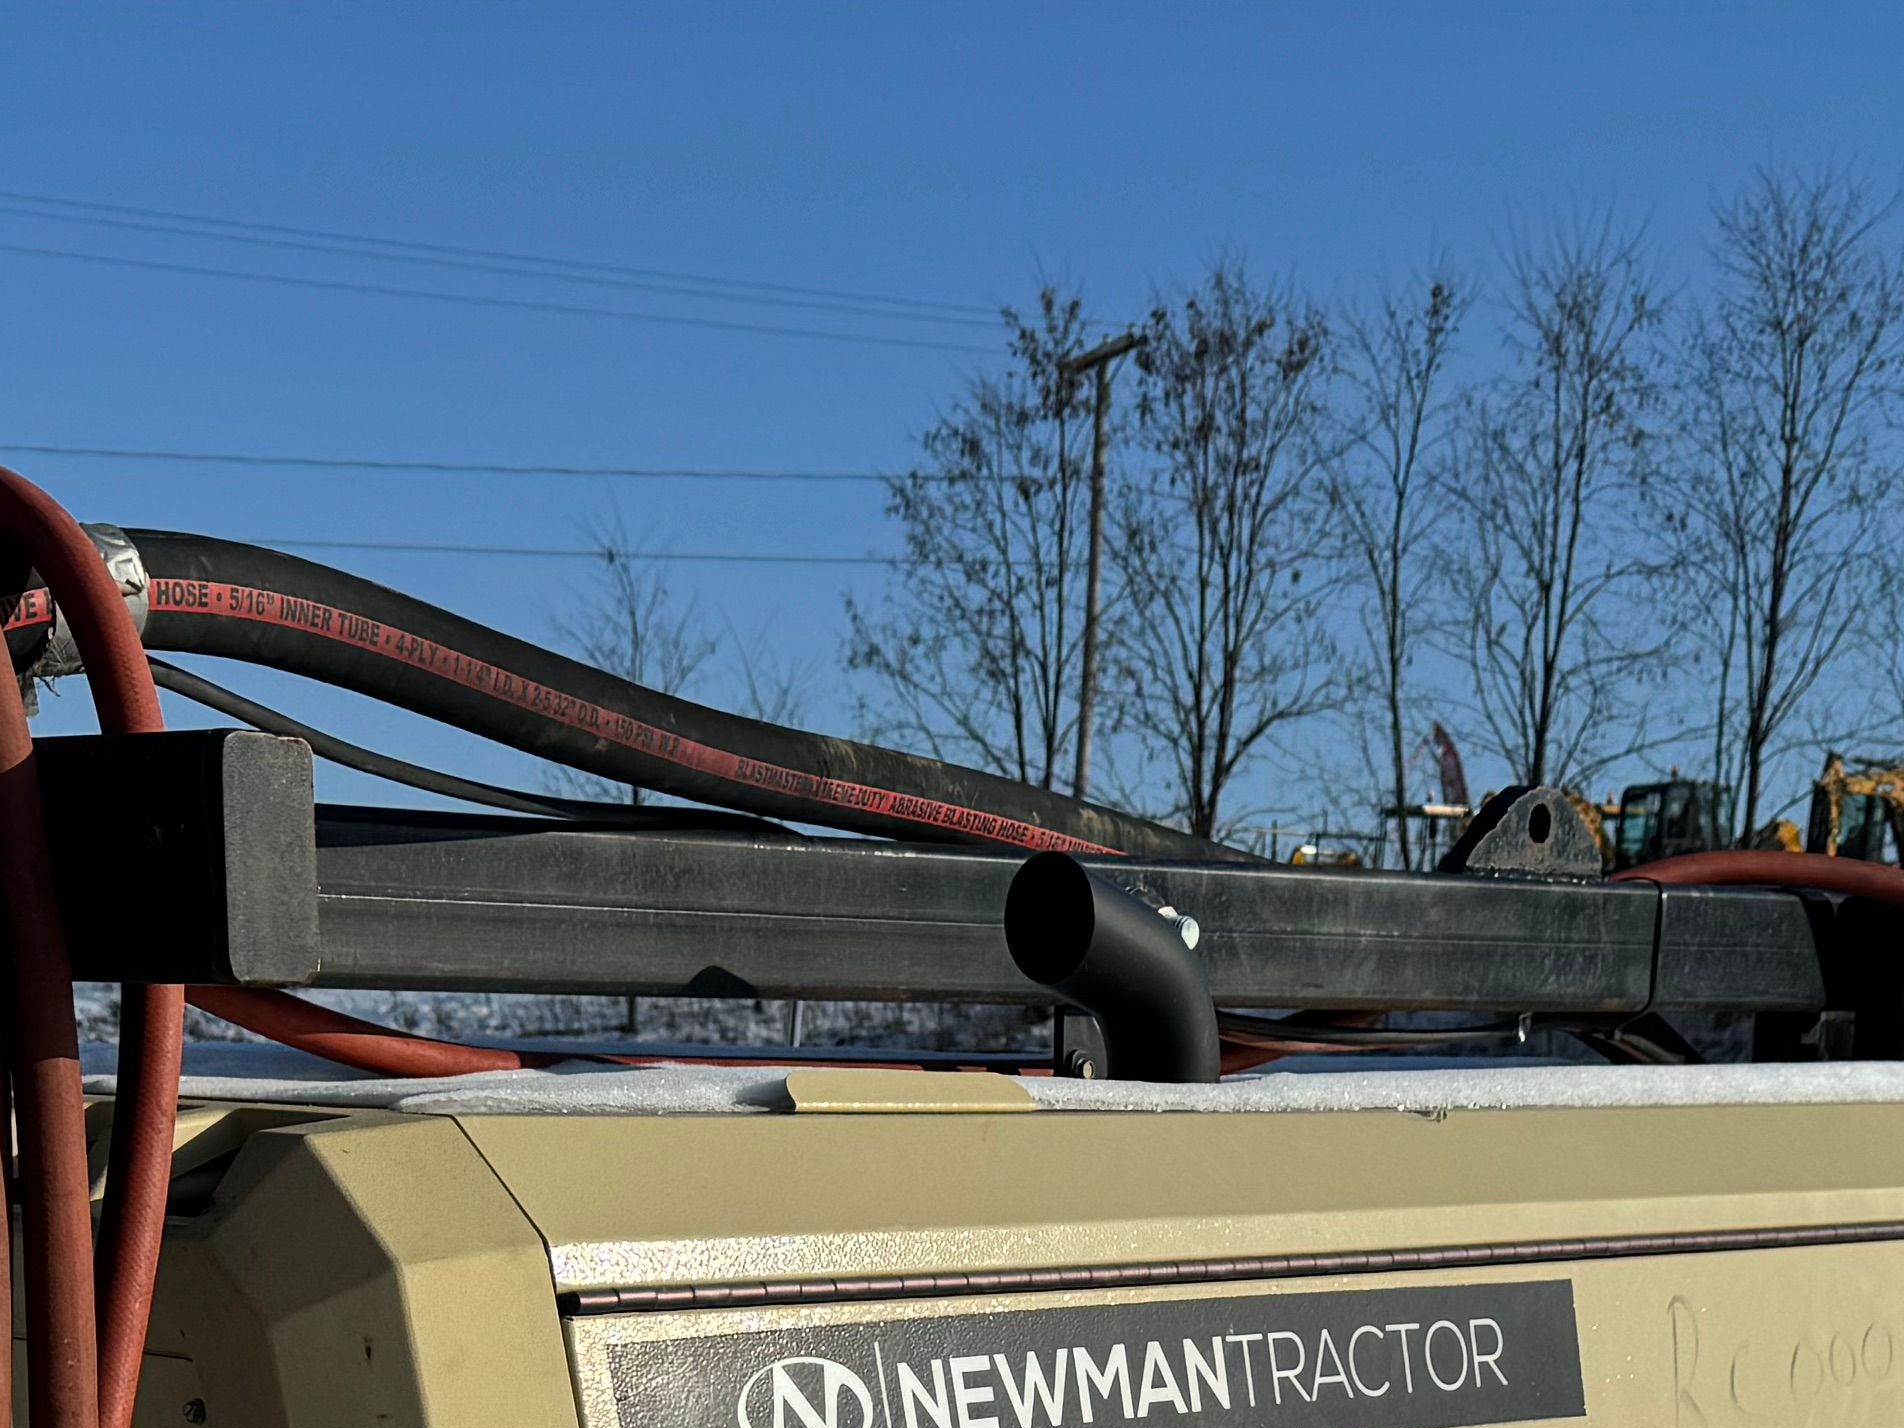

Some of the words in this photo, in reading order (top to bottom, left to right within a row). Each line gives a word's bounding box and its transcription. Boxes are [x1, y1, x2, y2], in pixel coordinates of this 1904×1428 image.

[156, 580, 209, 609] HOSE
[280, 595, 333, 633] INNER
[337, 612, 381, 648] TUBE
[396, 633, 438, 666] 4-PLY
[891, 795, 940, 824] ABRASIVE
[944, 808, 996, 836] BLASTING
[997, 820, 1028, 842] HOSE
